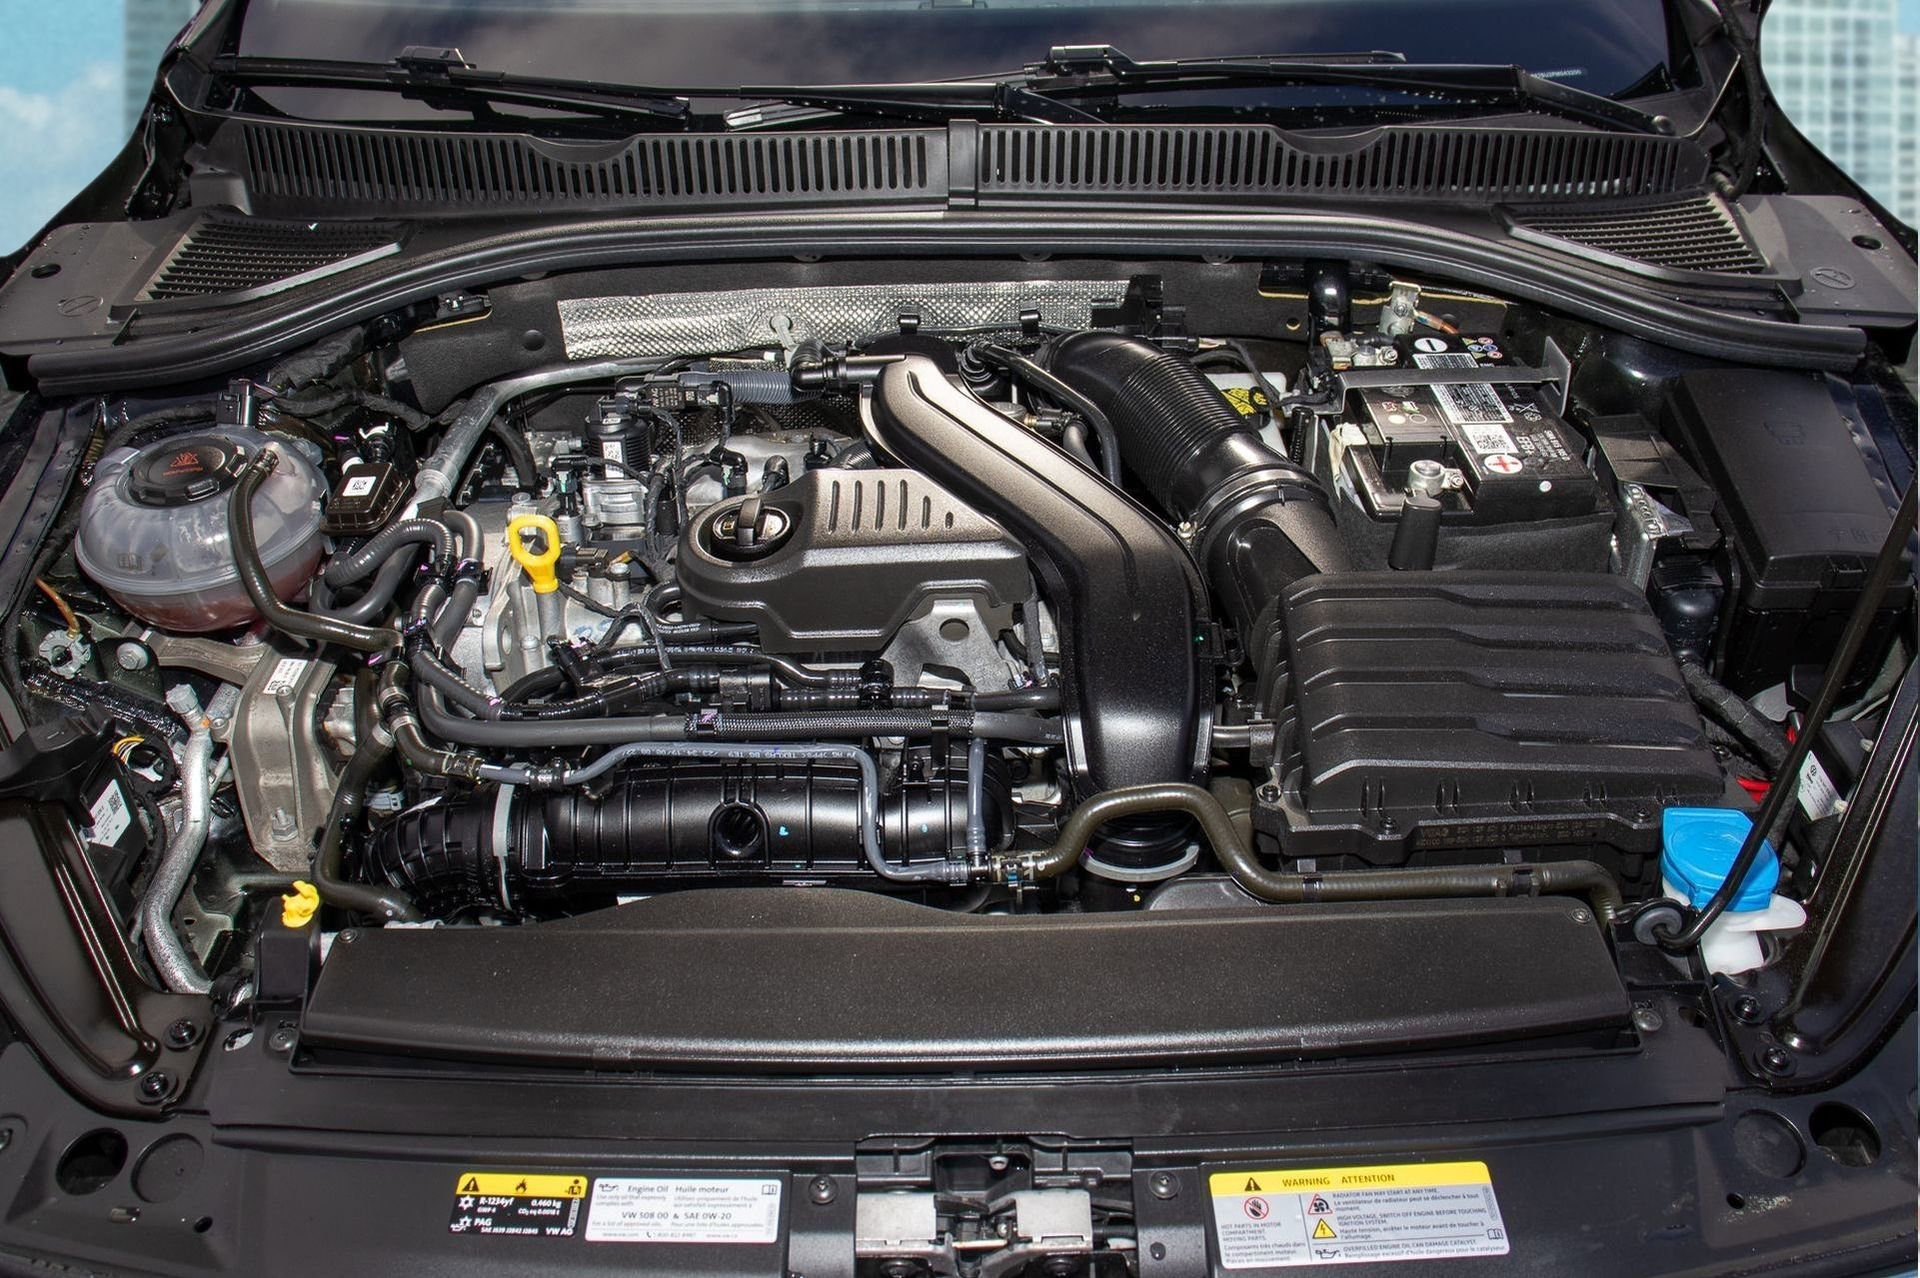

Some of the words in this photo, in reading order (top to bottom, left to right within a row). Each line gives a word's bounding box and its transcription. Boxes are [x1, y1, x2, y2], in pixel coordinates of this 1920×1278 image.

[1282, 1177, 1330, 1187] WARNING
[1341, 1174, 1395, 1184] ATTENTION
[628, 1185, 656, 1194] Engine
[479, 1197, 514, 1207] R-1234yf
[552, 1200, 562, 1208] kg
[622, 1211, 638, 1219] VW
[640, 1211, 655, 1219] 508
[474, 1217, 492, 1226] PAG
[545, 1227, 560, 1235] VW
